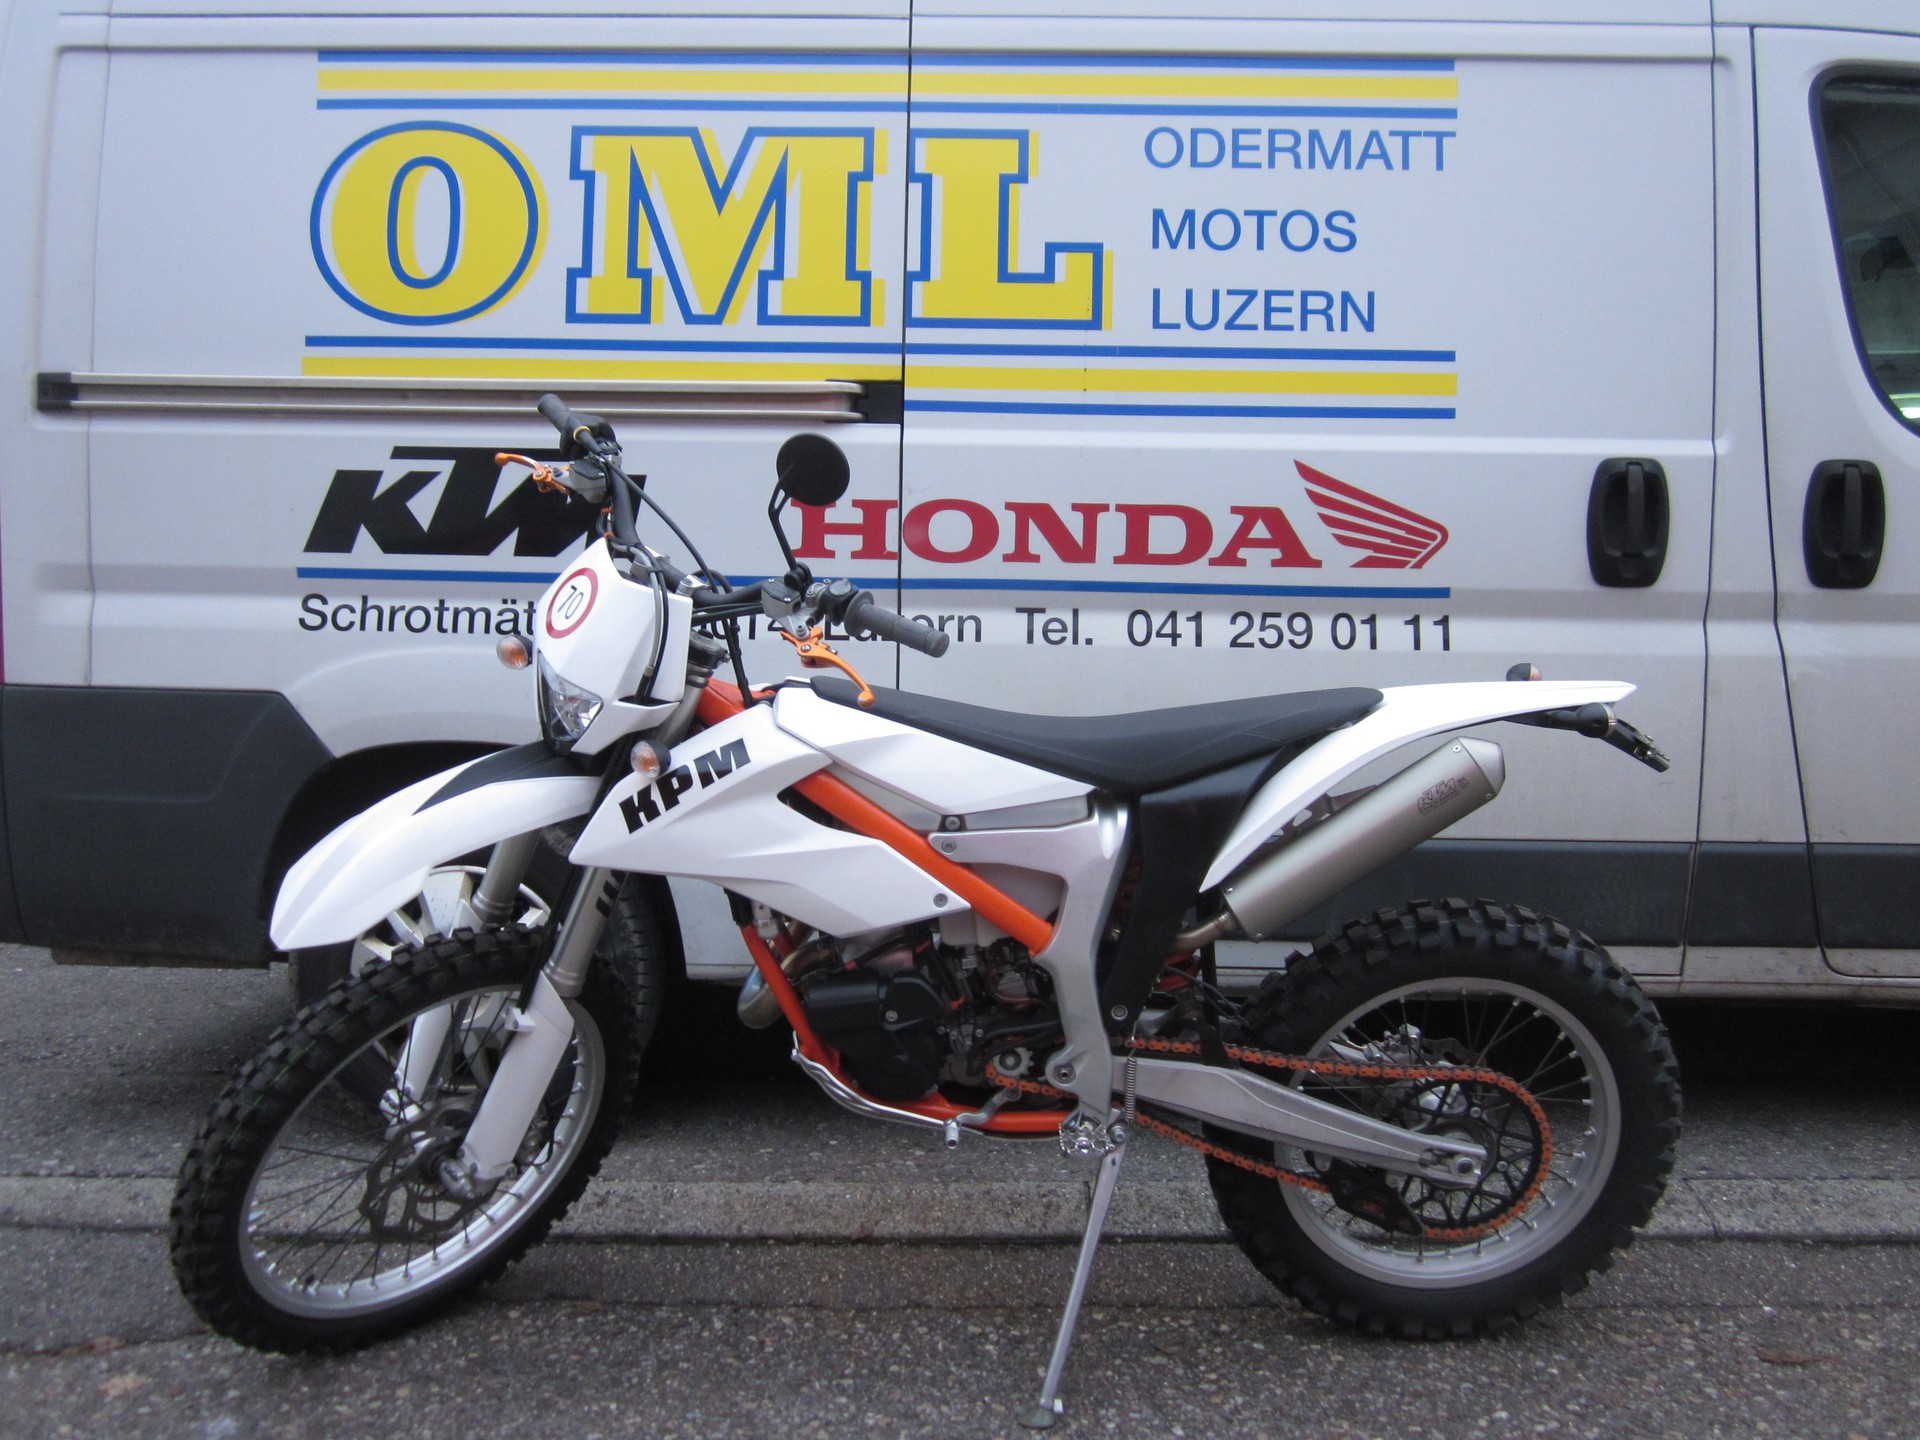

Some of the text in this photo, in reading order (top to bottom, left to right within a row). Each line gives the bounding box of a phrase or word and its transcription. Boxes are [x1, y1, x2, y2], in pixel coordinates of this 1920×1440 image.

[1144, 126, 1457, 172] ODERMATT
[309, 119, 1113, 331] OML
[1151, 207, 1358, 254] MOTOS
[1152, 287, 1376, 333] LUZERN
[303, 446, 648, 559] KTM
[790, 498, 1323, 569] HONDA
[557, 584, 584, 620] 70
[1015, 606, 1093, 646] Tel.
[1126, 608, 1204, 649] 041
[1229, 610, 1313, 650] 259
[1330, 611, 1382, 652] 01
[1403, 614, 1451, 653] 11
[618, 737, 752, 835] KPM
